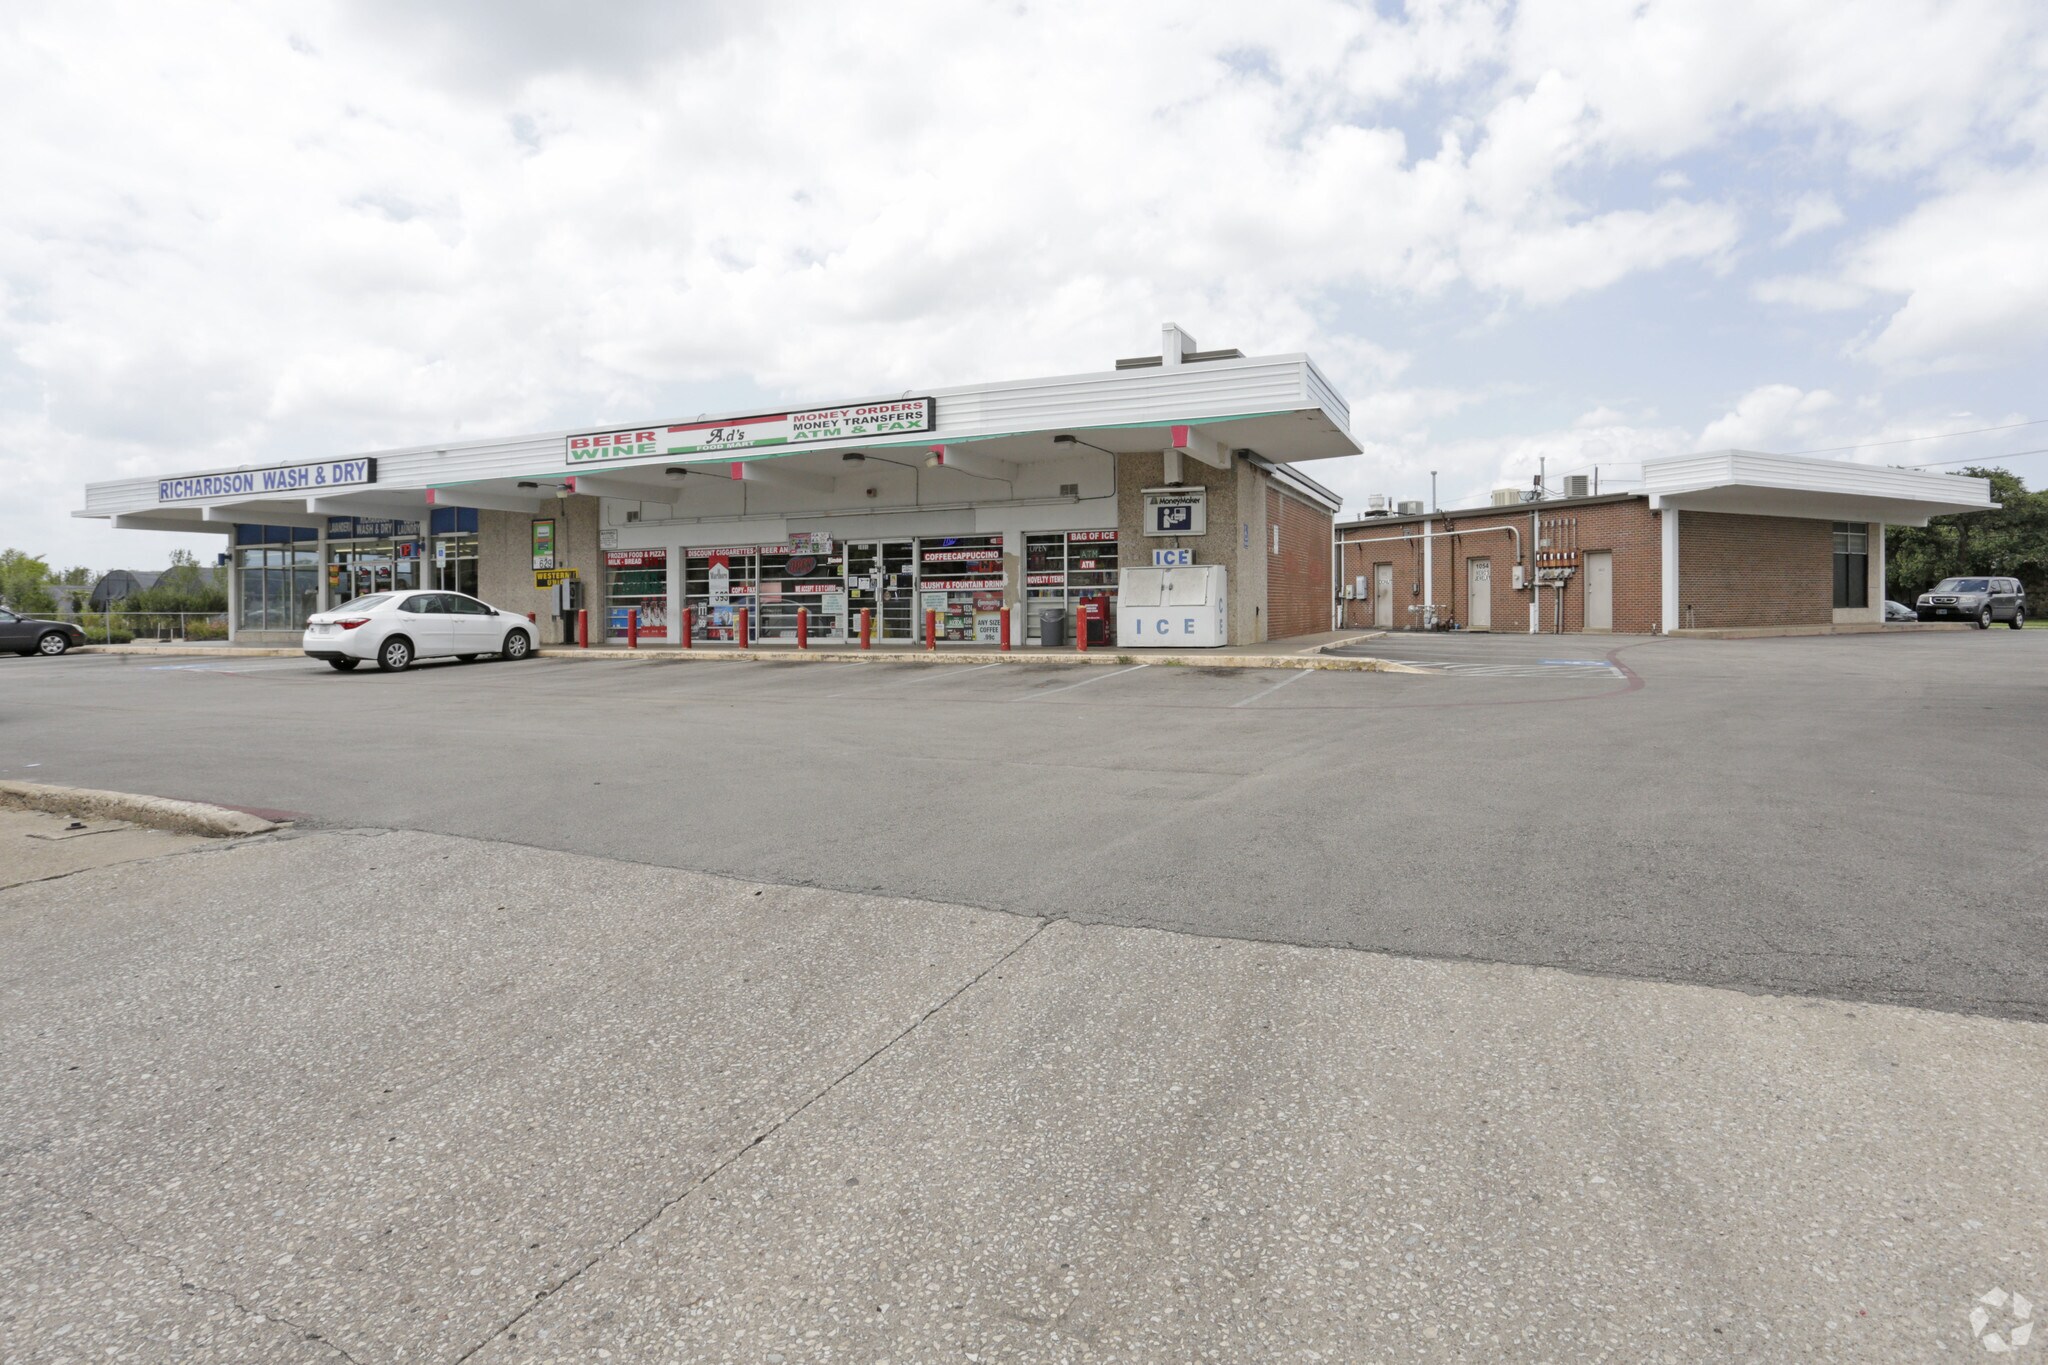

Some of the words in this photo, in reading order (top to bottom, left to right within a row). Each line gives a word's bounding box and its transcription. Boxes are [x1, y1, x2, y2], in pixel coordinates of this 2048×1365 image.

[793, 409, 850, 423] MONEY
[855, 402, 923, 416] ORDERS
[793, 420, 839, 431] MONEY
[843, 411, 924, 426] TRANSFERS
[794, 427, 842, 440] ATM
[851, 425, 867, 434] &
[876, 420, 922, 432] FAX
[570, 431, 657, 450] BEER
[696, 444, 725, 452] FOOD
[729, 440, 755, 449] MART
[571, 443, 657, 460] WINE
[160, 473, 254, 500] RICHARDSON
[263, 466, 309, 490] WASH
[315, 465, 327, 485] &
[332, 461, 367, 483] DRY
[1159, 497, 1201, 506] MoneyMaker
[356, 524, 377, 534] WASH
[375, 523, 380, 534] &
[380, 523, 393, 534] DRY
[1071, 533, 1087, 541] BAG
[1089, 532, 1100, 540] OF
[1101, 531, 1115, 540] ICE
[607, 551, 628, 559] FROZEN
[649, 550, 666, 558] PIZZA
[688, 549, 715, 557] DISCOUNT
[1081, 549, 1099, 558] ATM
[1156, 550, 1188, 565] ICE
[607, 558, 621, 566] MILK
[624, 558, 642, 566] BREAD
[1081, 560, 1095, 569] ATM
[537, 571, 570, 580] WESTERN
[1027, 576, 1048, 584] NOVELTY
[1049, 575, 1064, 583] ITEMS
[920, 581, 944, 589] SLUSHY
[945, 581, 951, 589] &
[952, 580, 984, 589] FOUNTAIN
[731, 586, 744, 594] COPY
[1136, 618, 1195, 635] ICE
